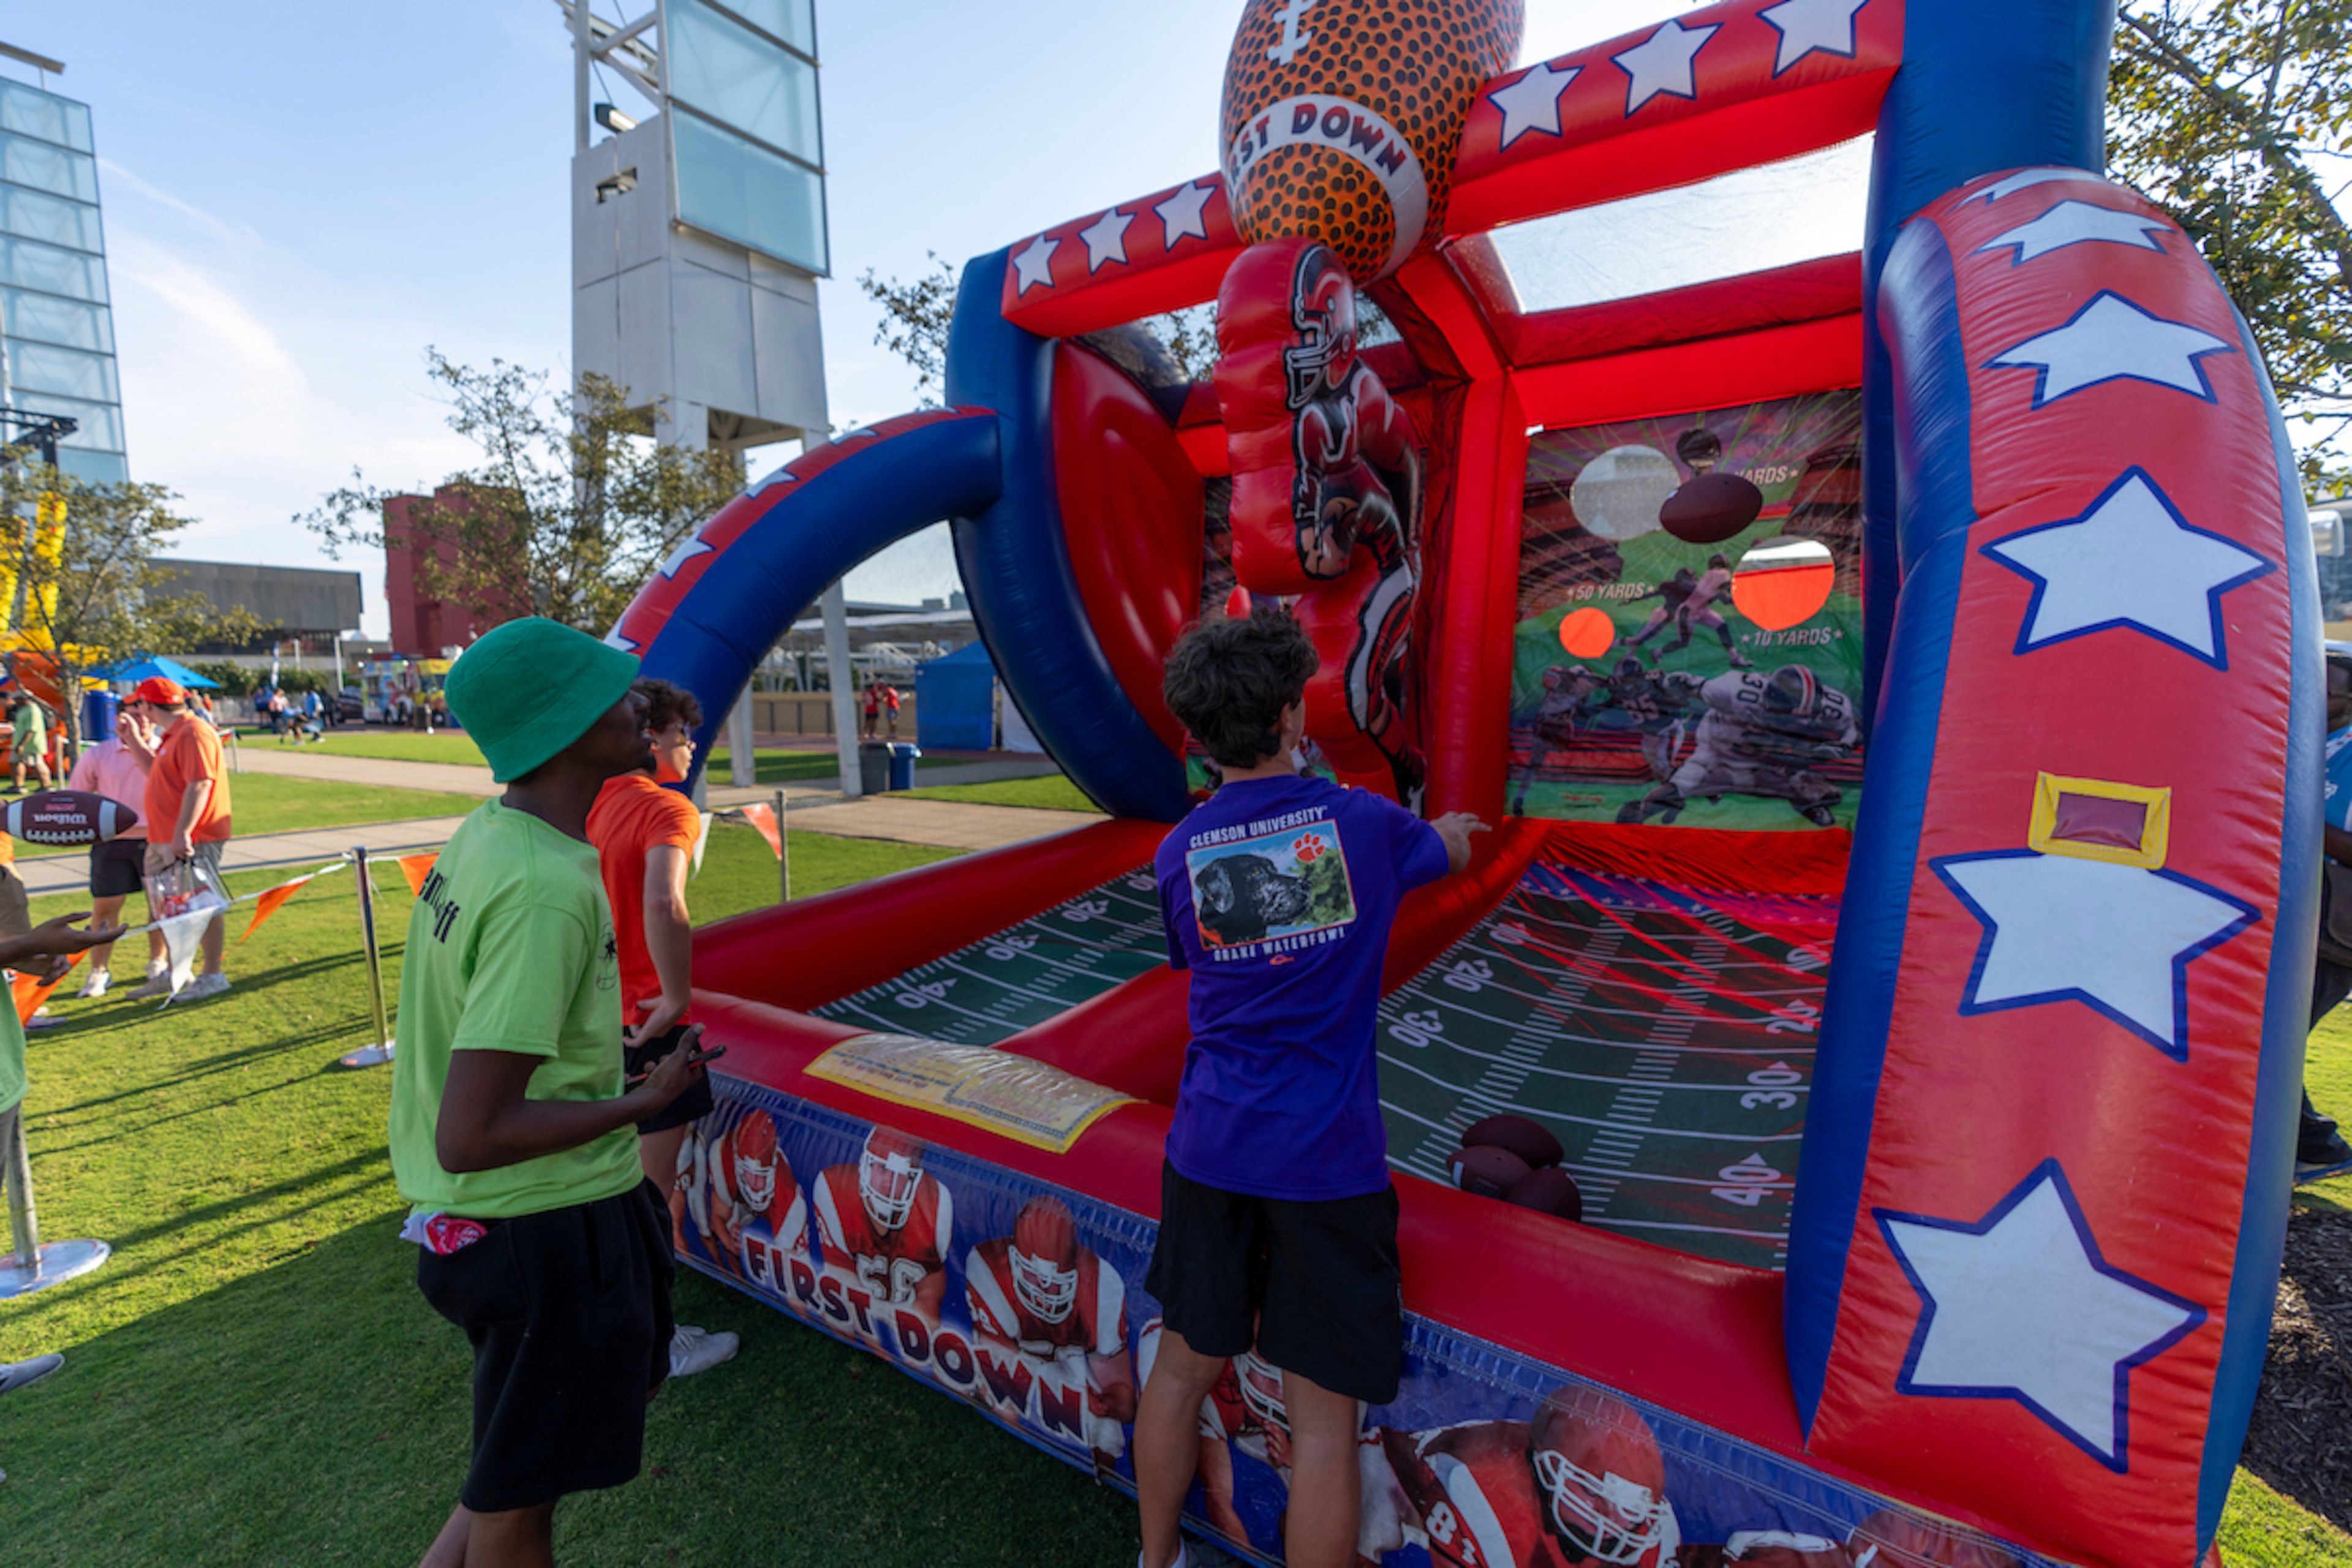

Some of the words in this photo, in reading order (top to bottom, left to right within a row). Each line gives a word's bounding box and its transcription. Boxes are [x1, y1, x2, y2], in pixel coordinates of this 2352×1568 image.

[1291, 103, 1407, 176] DOWN
[1577, 585, 1593, 600] 50
[1597, 582, 1647, 598] YARDS
[1754, 631, 1770, 646] 10
[1777, 628, 1832, 646] YARDS
[32, 813, 87, 824] Wilson
[1189, 824, 1247, 848] CLEMSON
[1250, 806, 1325, 836] UNIVERSITY
[986, 935, 1035, 961] 30
[1442, 960, 1493, 992] 20
[895, 982, 948, 1009] 40
[1387, 1011, 1444, 1048] 30
[1741, 1068, 1803, 1110] 30
[1710, 1163, 1781, 1207] 40
[743, 1232, 875, 1338] FIRST
[894, 1307, 1084, 1443] DOWN
